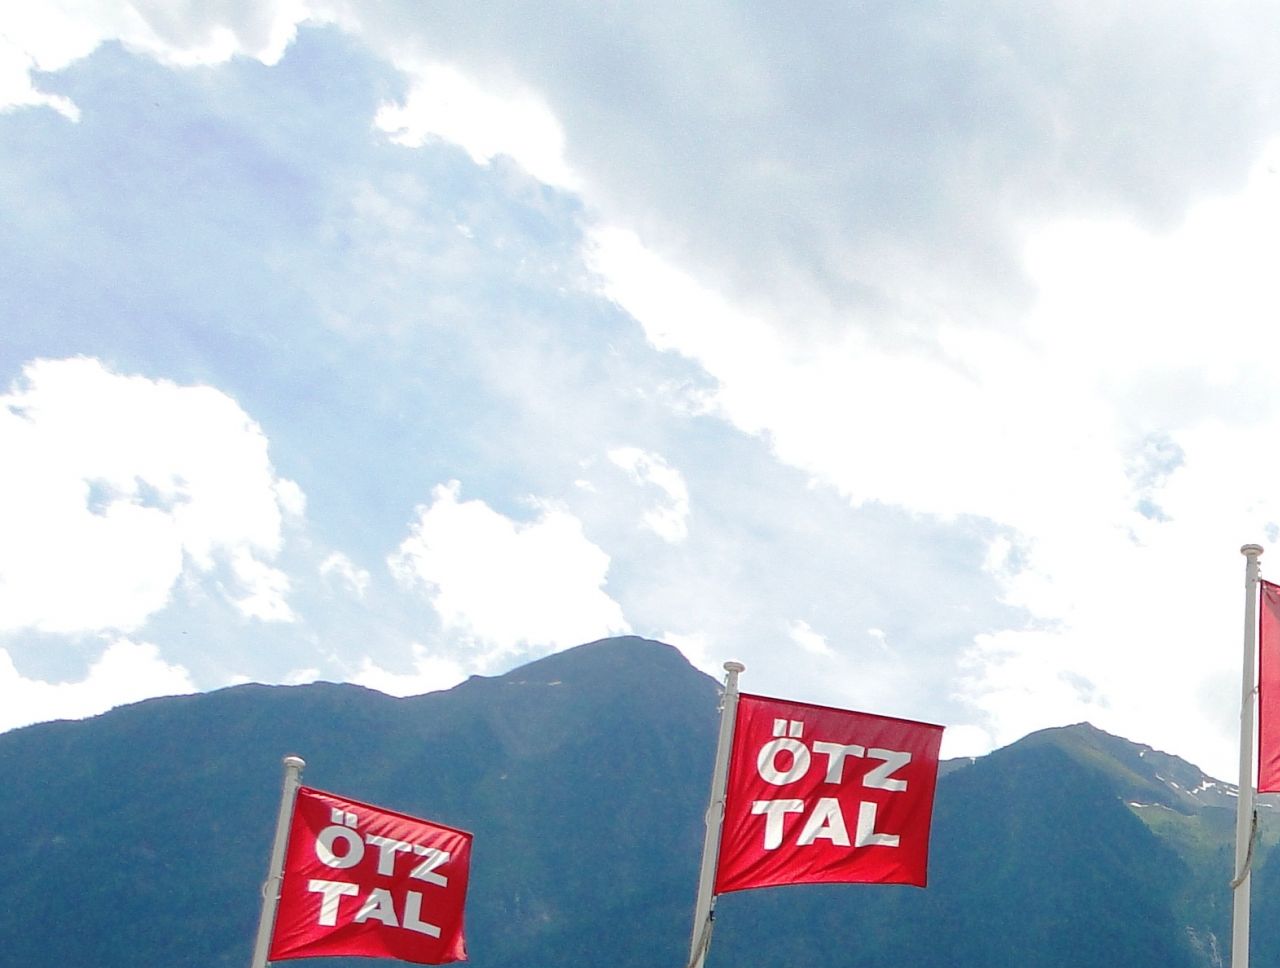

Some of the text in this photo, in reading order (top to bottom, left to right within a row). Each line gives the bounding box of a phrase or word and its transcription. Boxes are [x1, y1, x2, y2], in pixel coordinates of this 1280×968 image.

[757, 719, 912, 792] ÖTZ
[315, 807, 451, 888] ÖTZ
[751, 797, 900, 851] TAL
[307, 879, 443, 939] TAL
